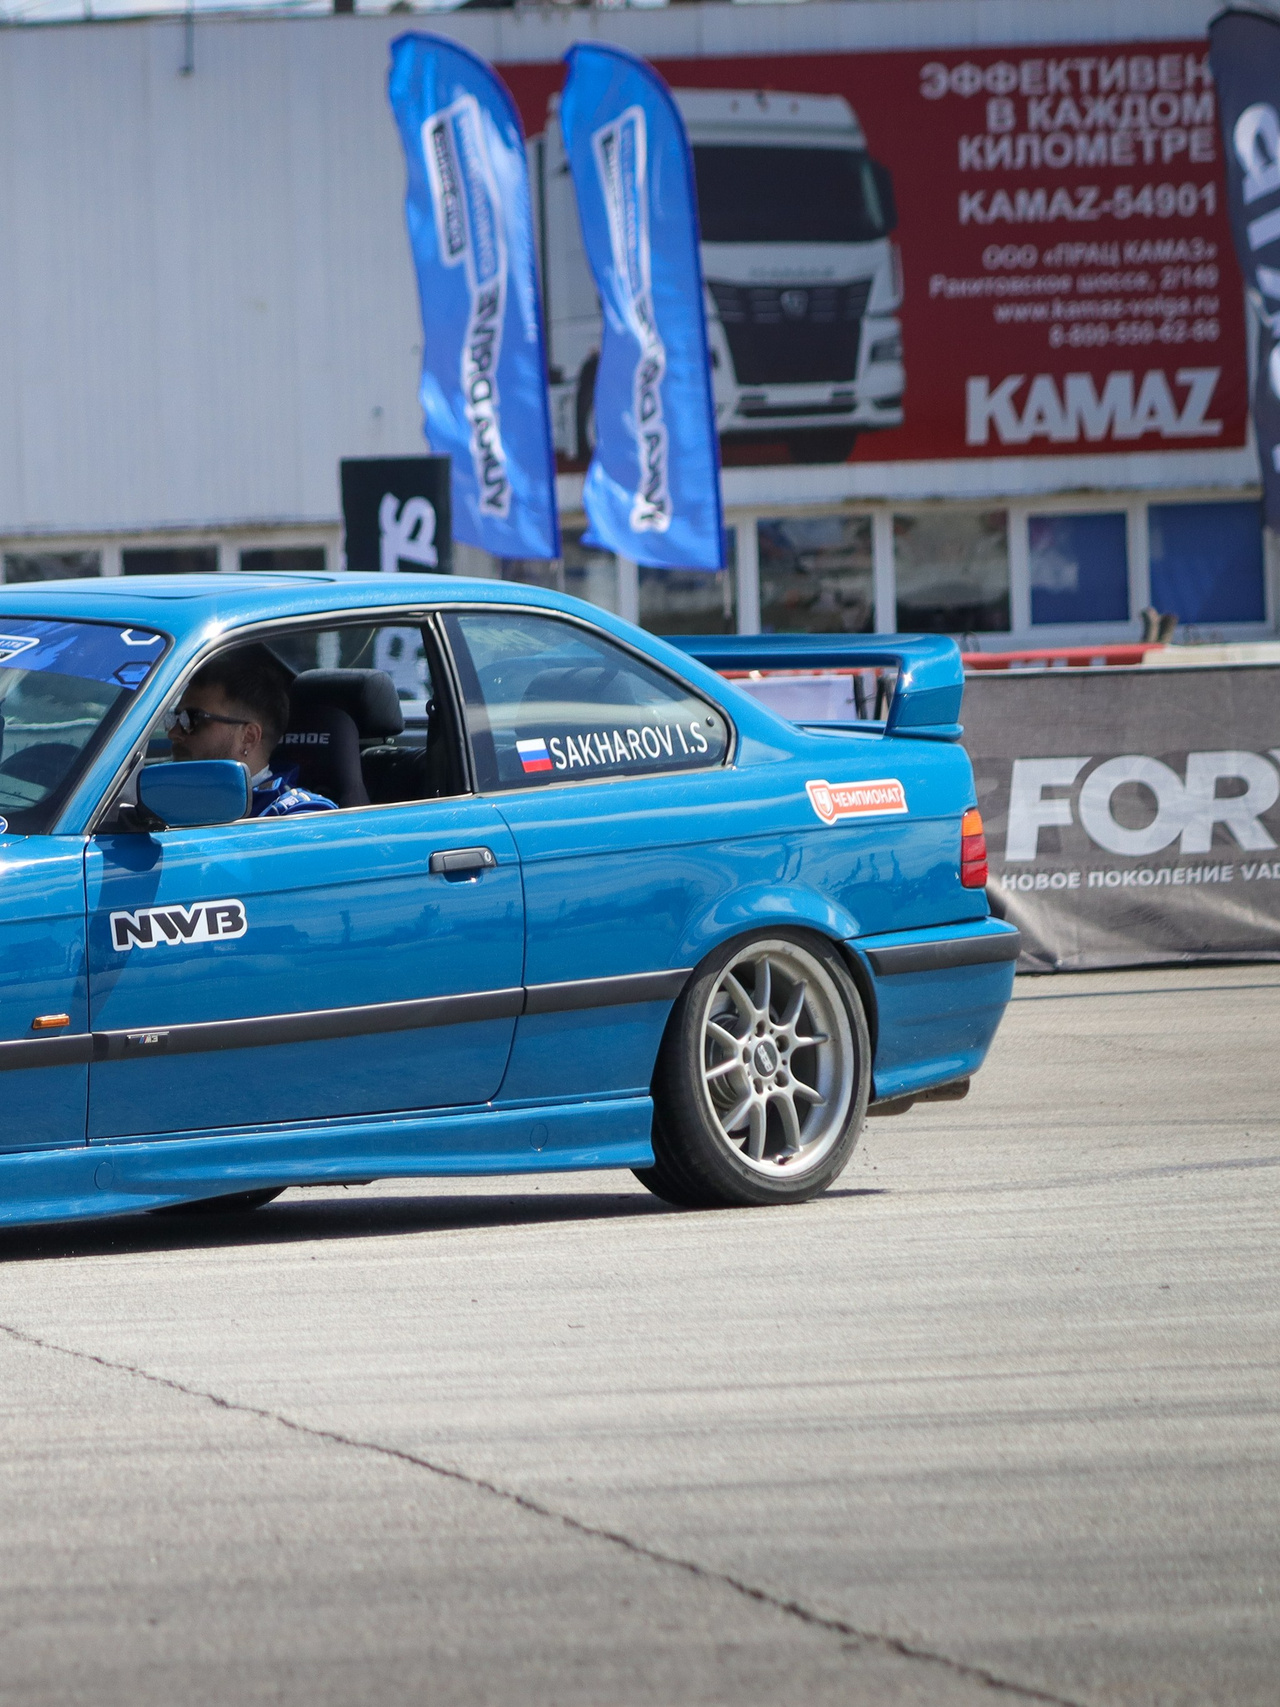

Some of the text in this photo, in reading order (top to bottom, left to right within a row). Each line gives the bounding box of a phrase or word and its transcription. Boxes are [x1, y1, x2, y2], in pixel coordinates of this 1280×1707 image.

[920, 53, 1214, 99] ЭФФЕКТИВЕН
[986, 90, 1215, 133] В КАЖДОМ
[958, 126, 1216, 172] КИЛОМЕТРЕ
[959, 182, 1216, 225] KAMAZ-54901
[982, 244, 1038, 270] ООО
[965, 366, 1224, 447] KAMAZ
[278, 733, 331, 744] RIDE
[549, 721, 708, 771] SAKHAROV I.S
[831, 787, 900, 807] ЧЕМПИОНАТ
[1005, 749, 1280, 862] FOR
[1002, 871, 1081, 891] НОВОЕ
[1088, 865, 1234, 888] ПОКОЛЕНИЕ
[114, 905, 244, 946] NWB
